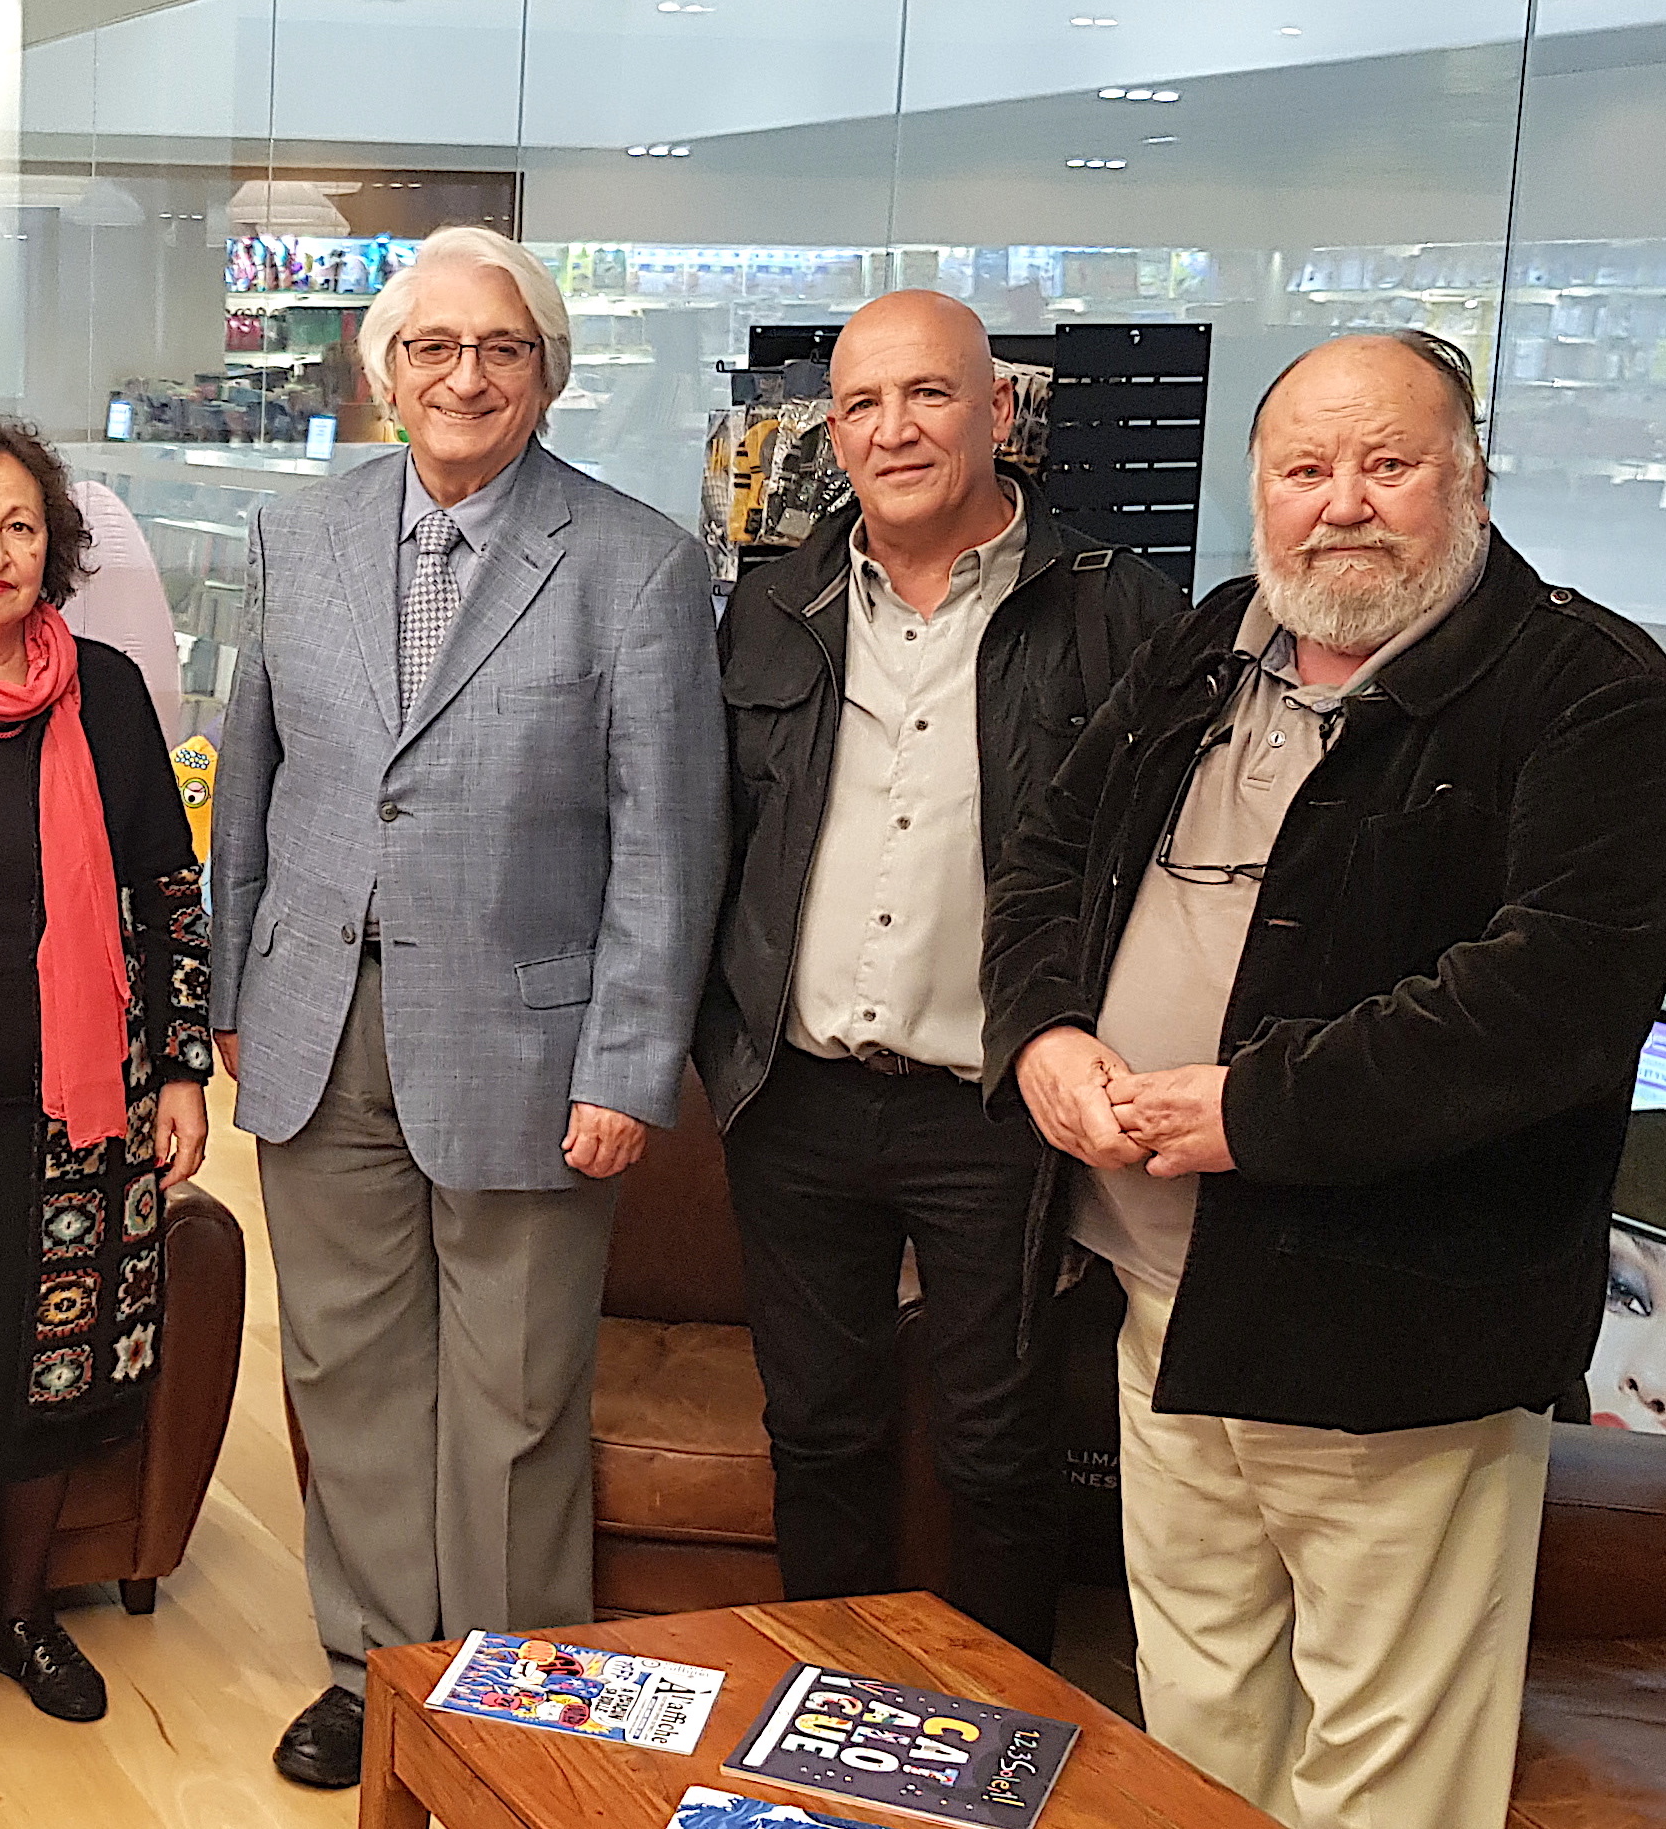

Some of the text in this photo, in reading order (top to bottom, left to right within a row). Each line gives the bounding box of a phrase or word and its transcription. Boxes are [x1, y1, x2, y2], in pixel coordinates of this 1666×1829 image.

[651, 1694, 695, 1744] l'affiche
[654, 1677, 712, 1695] À
[779, 1690, 865, 1760] GUE
[838, 1699, 923, 1774] ALO
[901, 1715, 982, 1788] CAT
